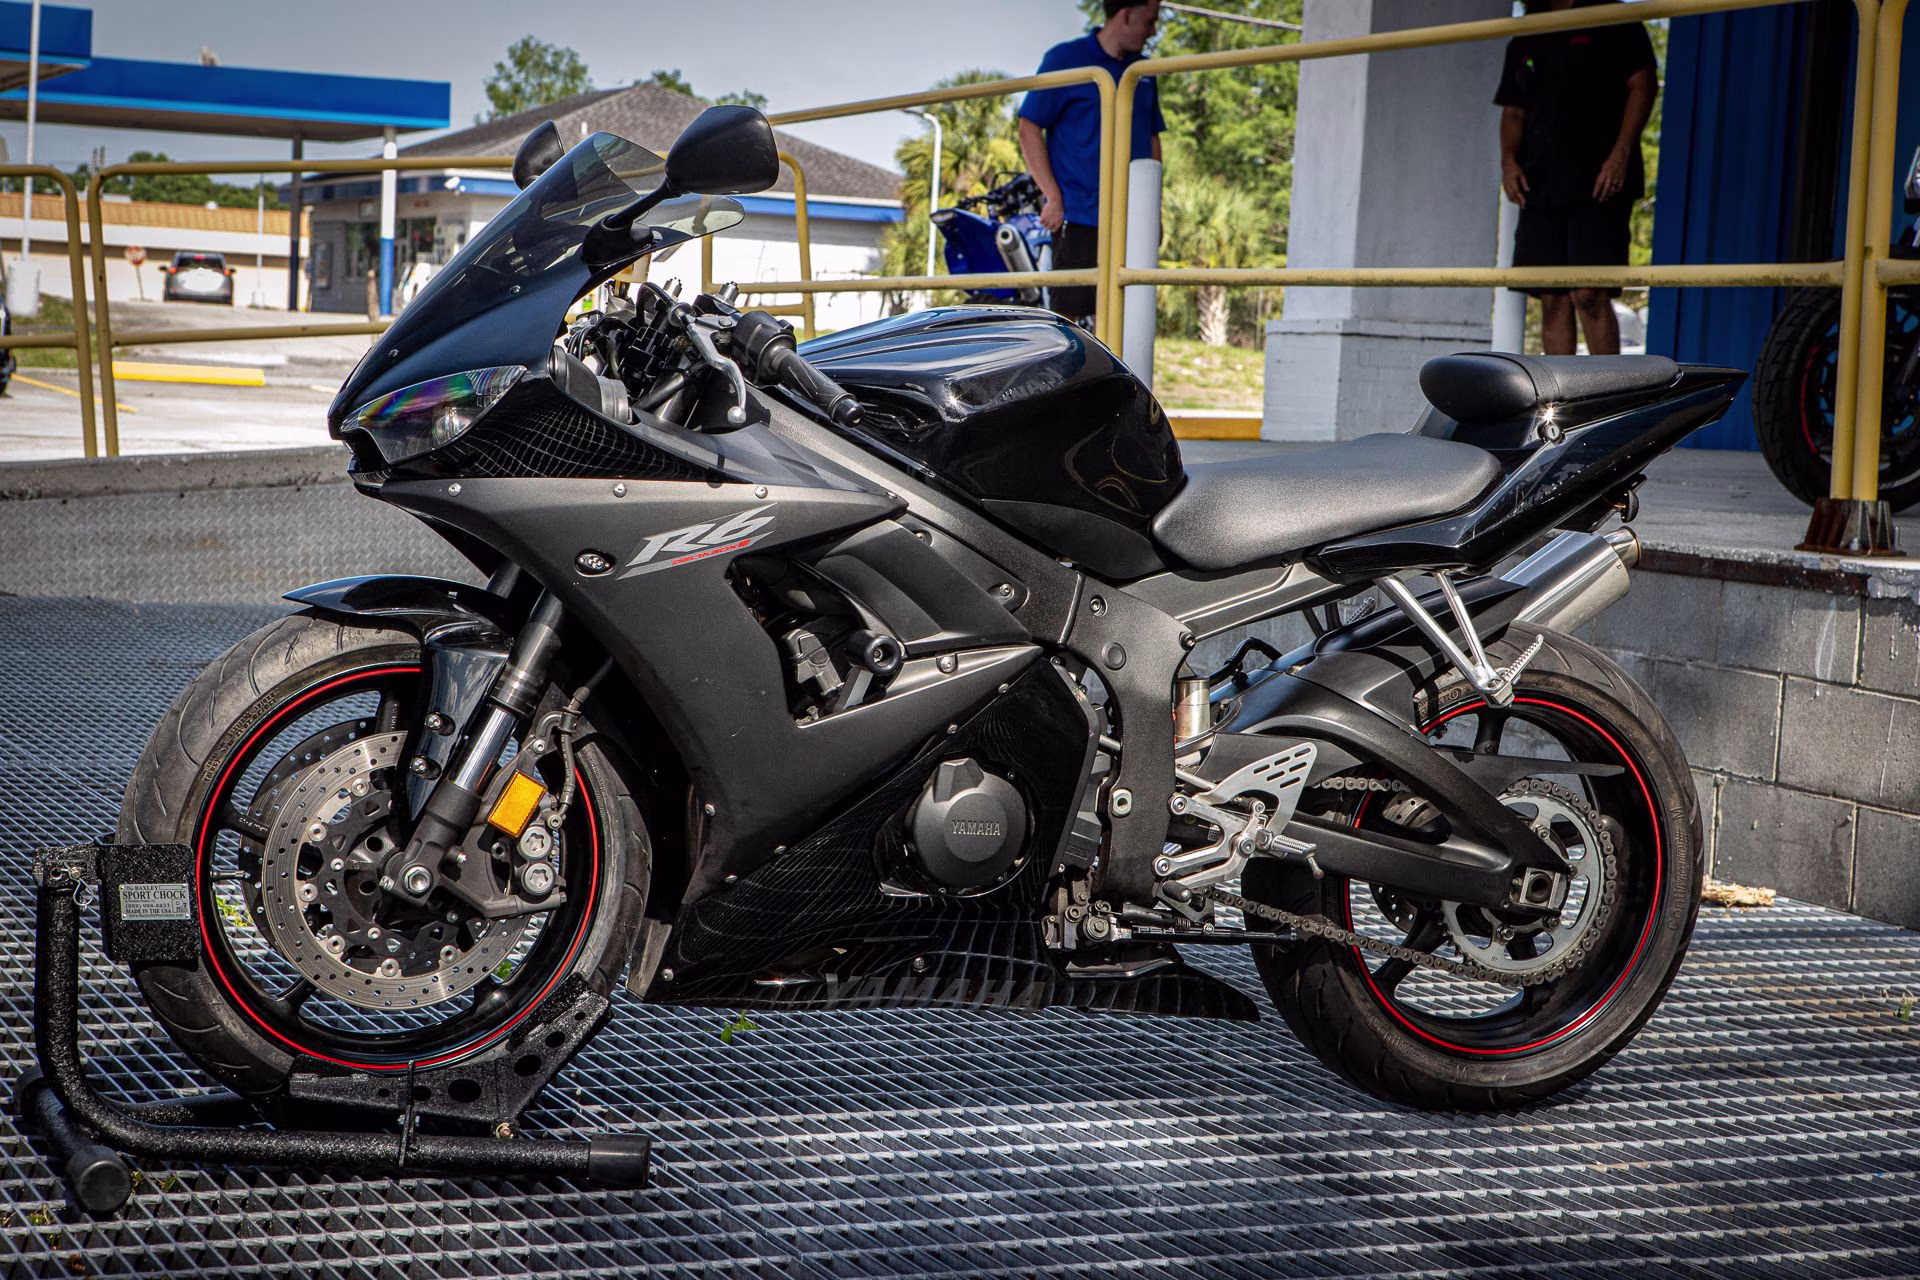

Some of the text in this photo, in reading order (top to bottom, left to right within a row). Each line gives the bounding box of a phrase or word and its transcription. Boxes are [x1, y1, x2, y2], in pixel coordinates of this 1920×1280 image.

[625, 503, 777, 567] R6
[952, 820, 1001, 836] YAMAHA
[122, 890, 186, 900] SPORT CHOCK
[825, 973, 1046, 1012] YAMAHA
